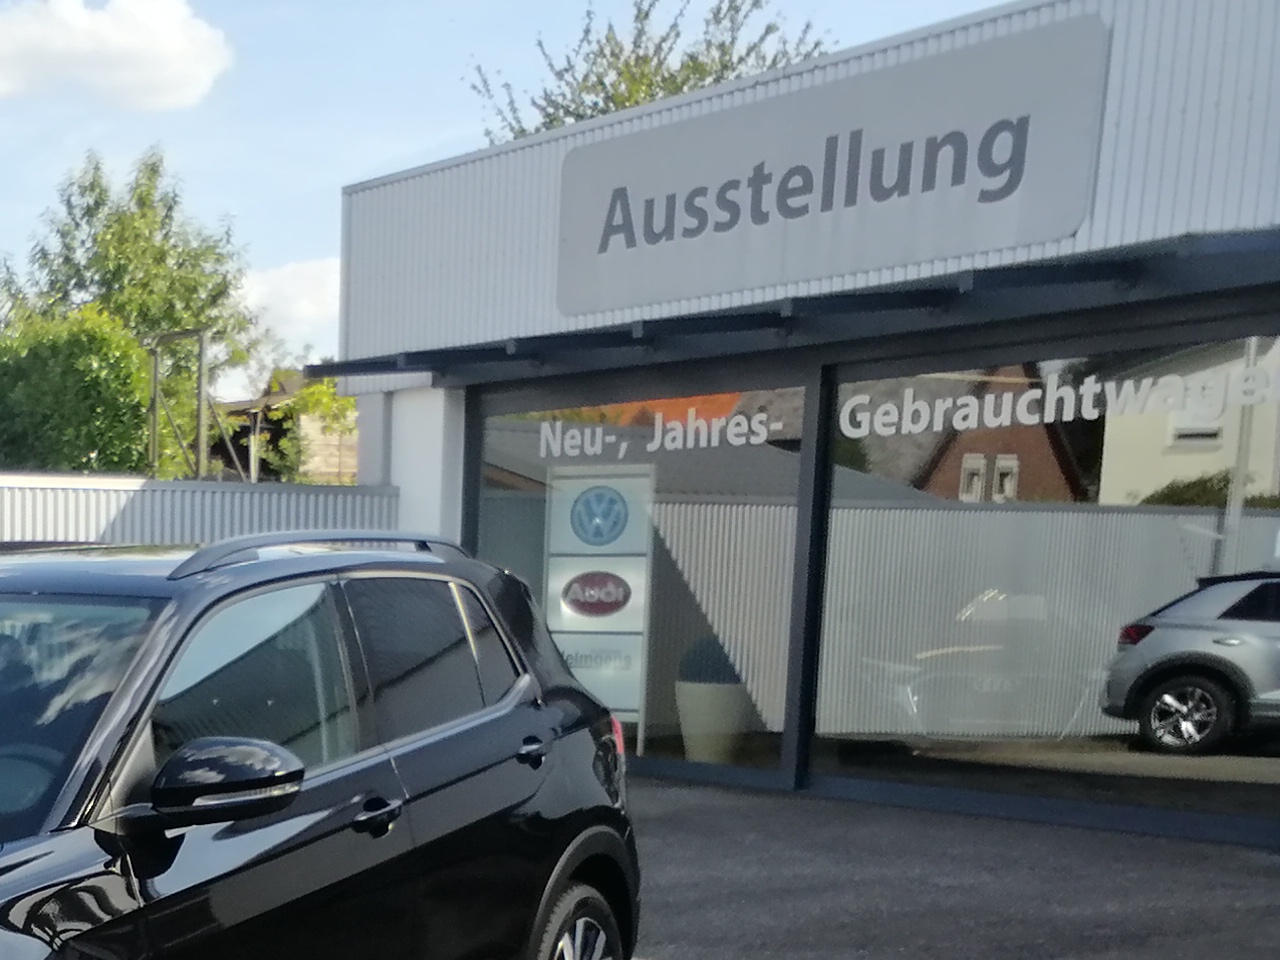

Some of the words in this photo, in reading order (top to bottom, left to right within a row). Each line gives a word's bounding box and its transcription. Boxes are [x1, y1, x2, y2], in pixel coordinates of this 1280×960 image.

[597, 113, 1031, 254] Ausstellung
[540, 420, 629, 459] Neu-,
[646, 407, 783, 452] Jahres-
[838, 366, 1278, 439] Gebrauchtwage
[566, 582, 626, 604] Audi
